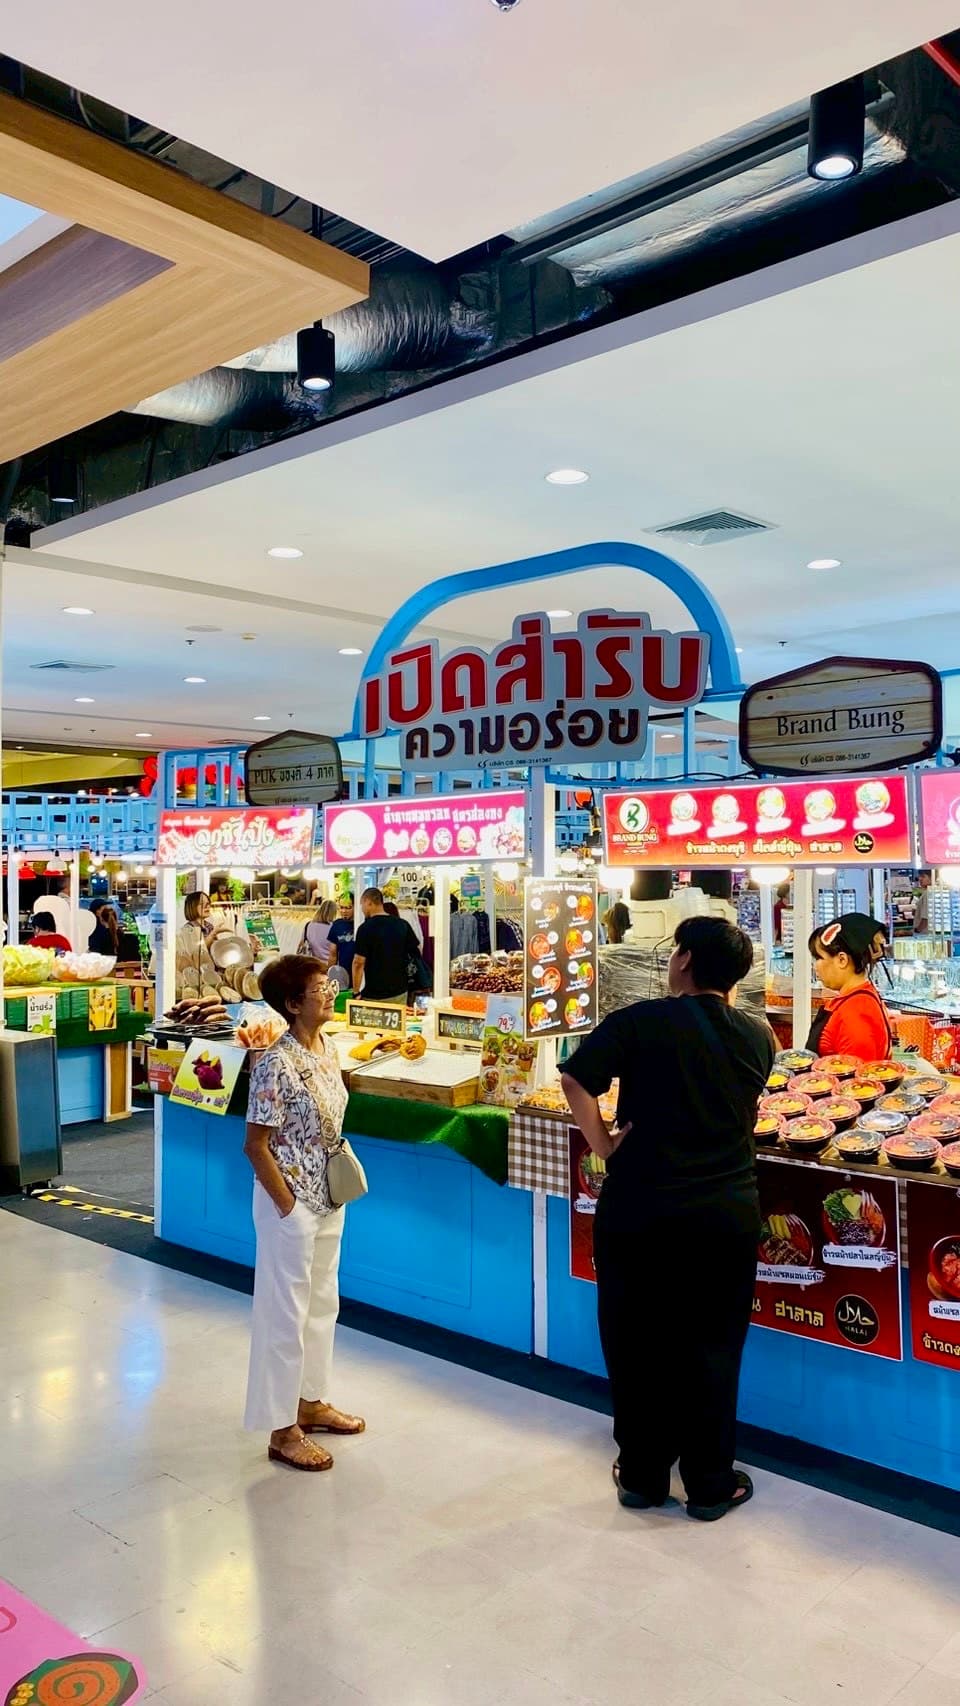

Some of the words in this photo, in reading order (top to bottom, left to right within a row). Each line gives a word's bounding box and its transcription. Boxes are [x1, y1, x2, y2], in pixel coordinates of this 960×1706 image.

[365, 614, 702, 734] เปิดสำรับ
[405, 699, 640, 759] ความอร่อย
[776, 709, 838, 737] Brand
[847, 707, 905, 734] Bung
[254, 768, 276, 785] PUK
[306, 765, 313, 780] 4
[317, 766, 334, 779] ภาค
[194, 812, 274, 853] ลูกชิ้นปิ้ง
[612, 833, 637, 842] BRAND
[637, 832, 657, 842] BUNG
[400, 872, 418, 882] 100
[384, 1011, 399, 1028] 79
[775, 1300, 824, 1327] ฮาลาล
[933, 1304, 960, 1316] หน้าแซล
[922, 1332, 960, 1356] ข้าวดง
